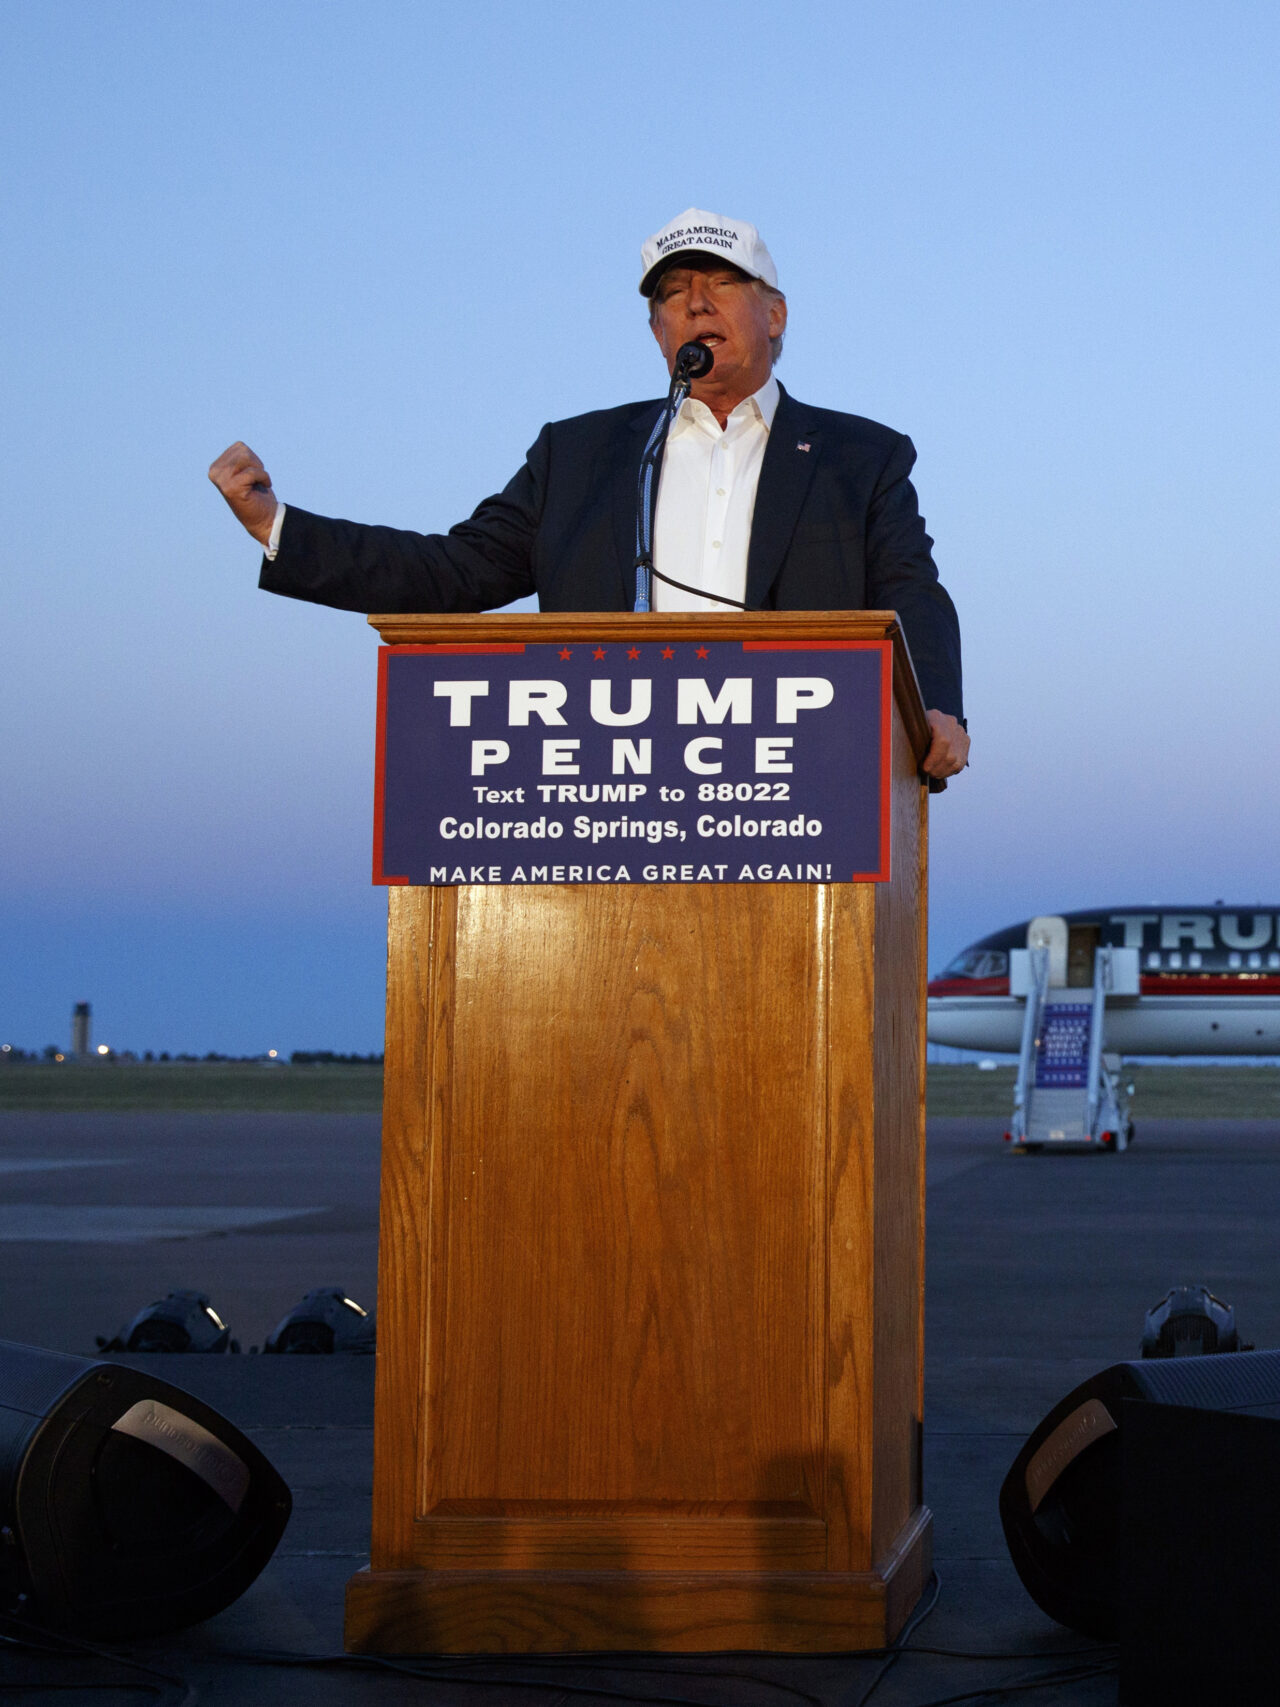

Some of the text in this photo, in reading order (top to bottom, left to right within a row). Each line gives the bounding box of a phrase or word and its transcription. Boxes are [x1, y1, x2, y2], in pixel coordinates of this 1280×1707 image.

[656, 226, 739, 250] MAKE AMERICA
[662, 236, 733, 255] GREAT AGAIN
[433, 677, 835, 727] TRUMP
[470, 736, 794, 776] PENCE
[472, 783, 790, 804] Text TRUMP to 88022
[439, 814, 823, 844] Colorado Springs, Colorado
[430, 863, 833, 883] MAKE AMERICA GREAT AGAIN!
